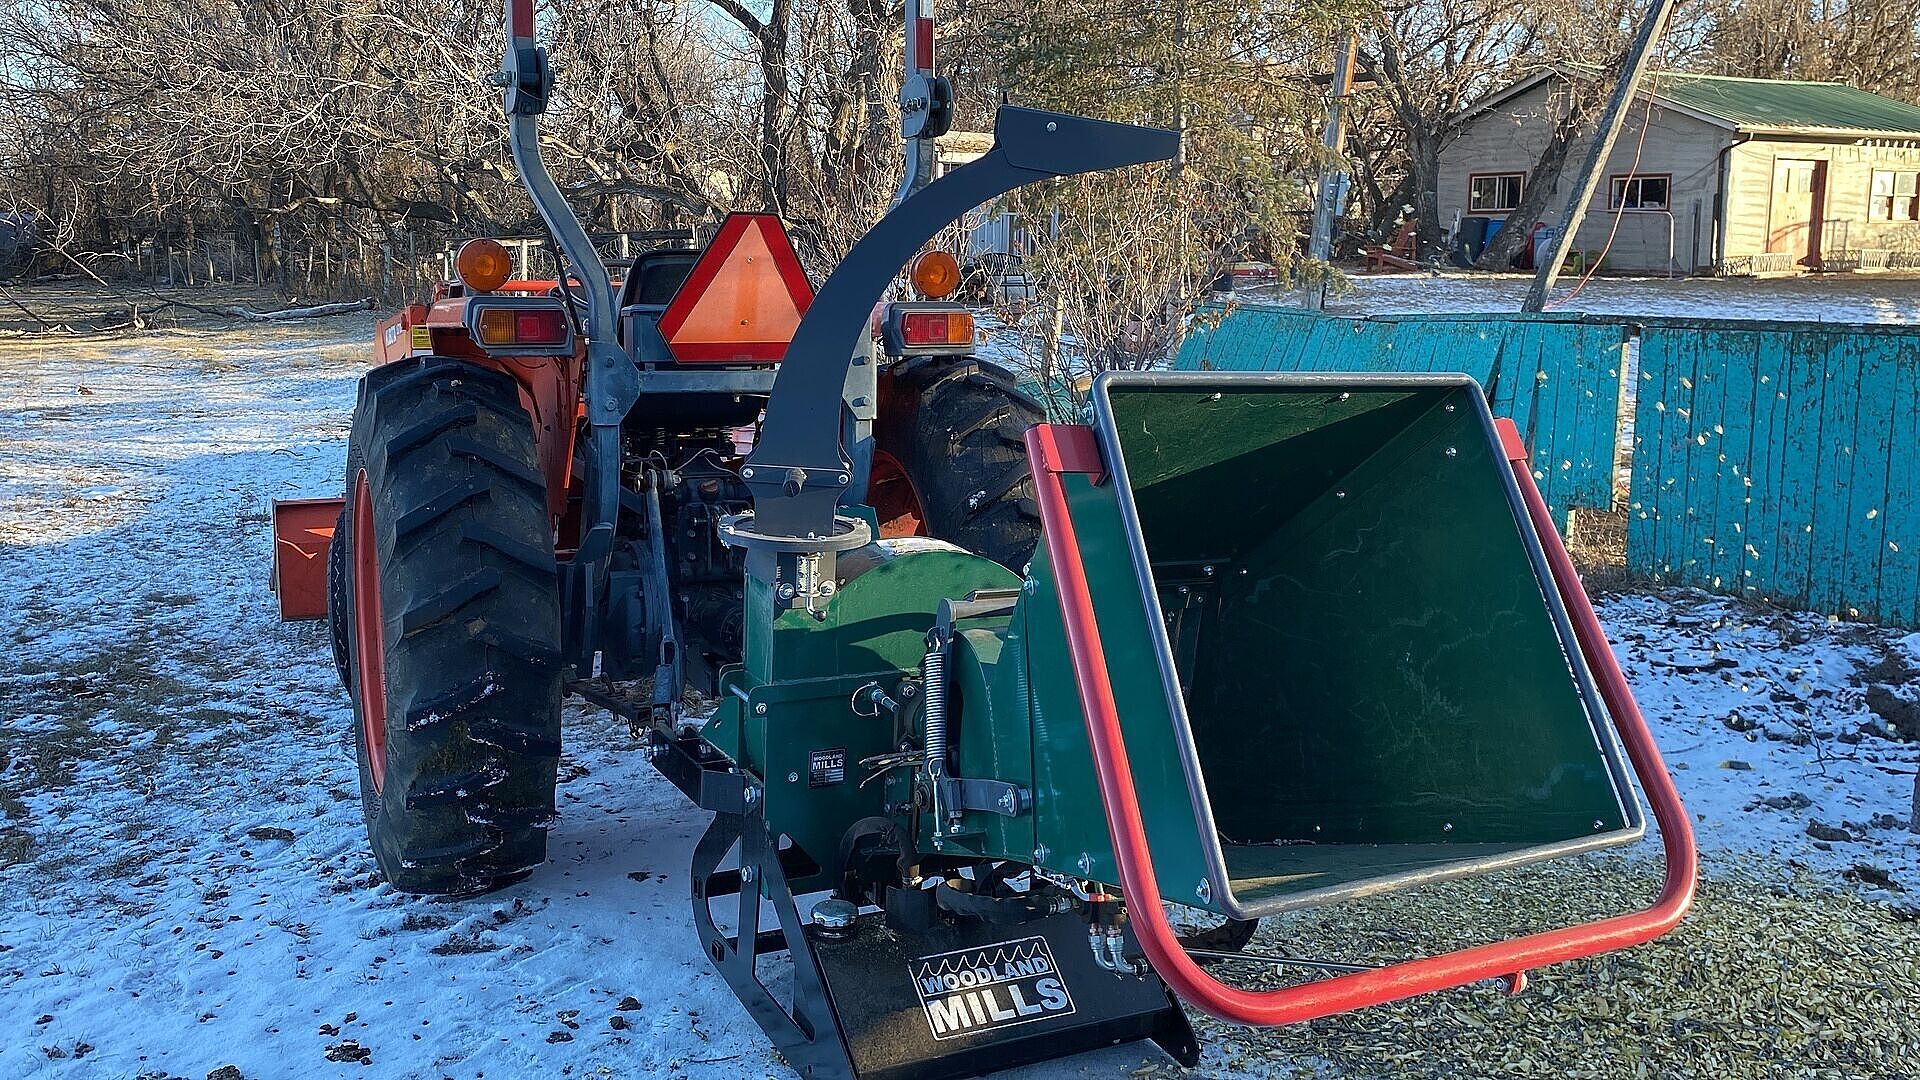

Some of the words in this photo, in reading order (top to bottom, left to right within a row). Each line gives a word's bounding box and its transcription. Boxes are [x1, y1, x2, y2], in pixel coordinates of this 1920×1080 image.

[812, 759, 844, 770] MILLS
[813, 753, 843, 761] WOODLAND
[921, 957, 1050, 993] WOODLAND
[927, 977, 1068, 1033] MILLS
